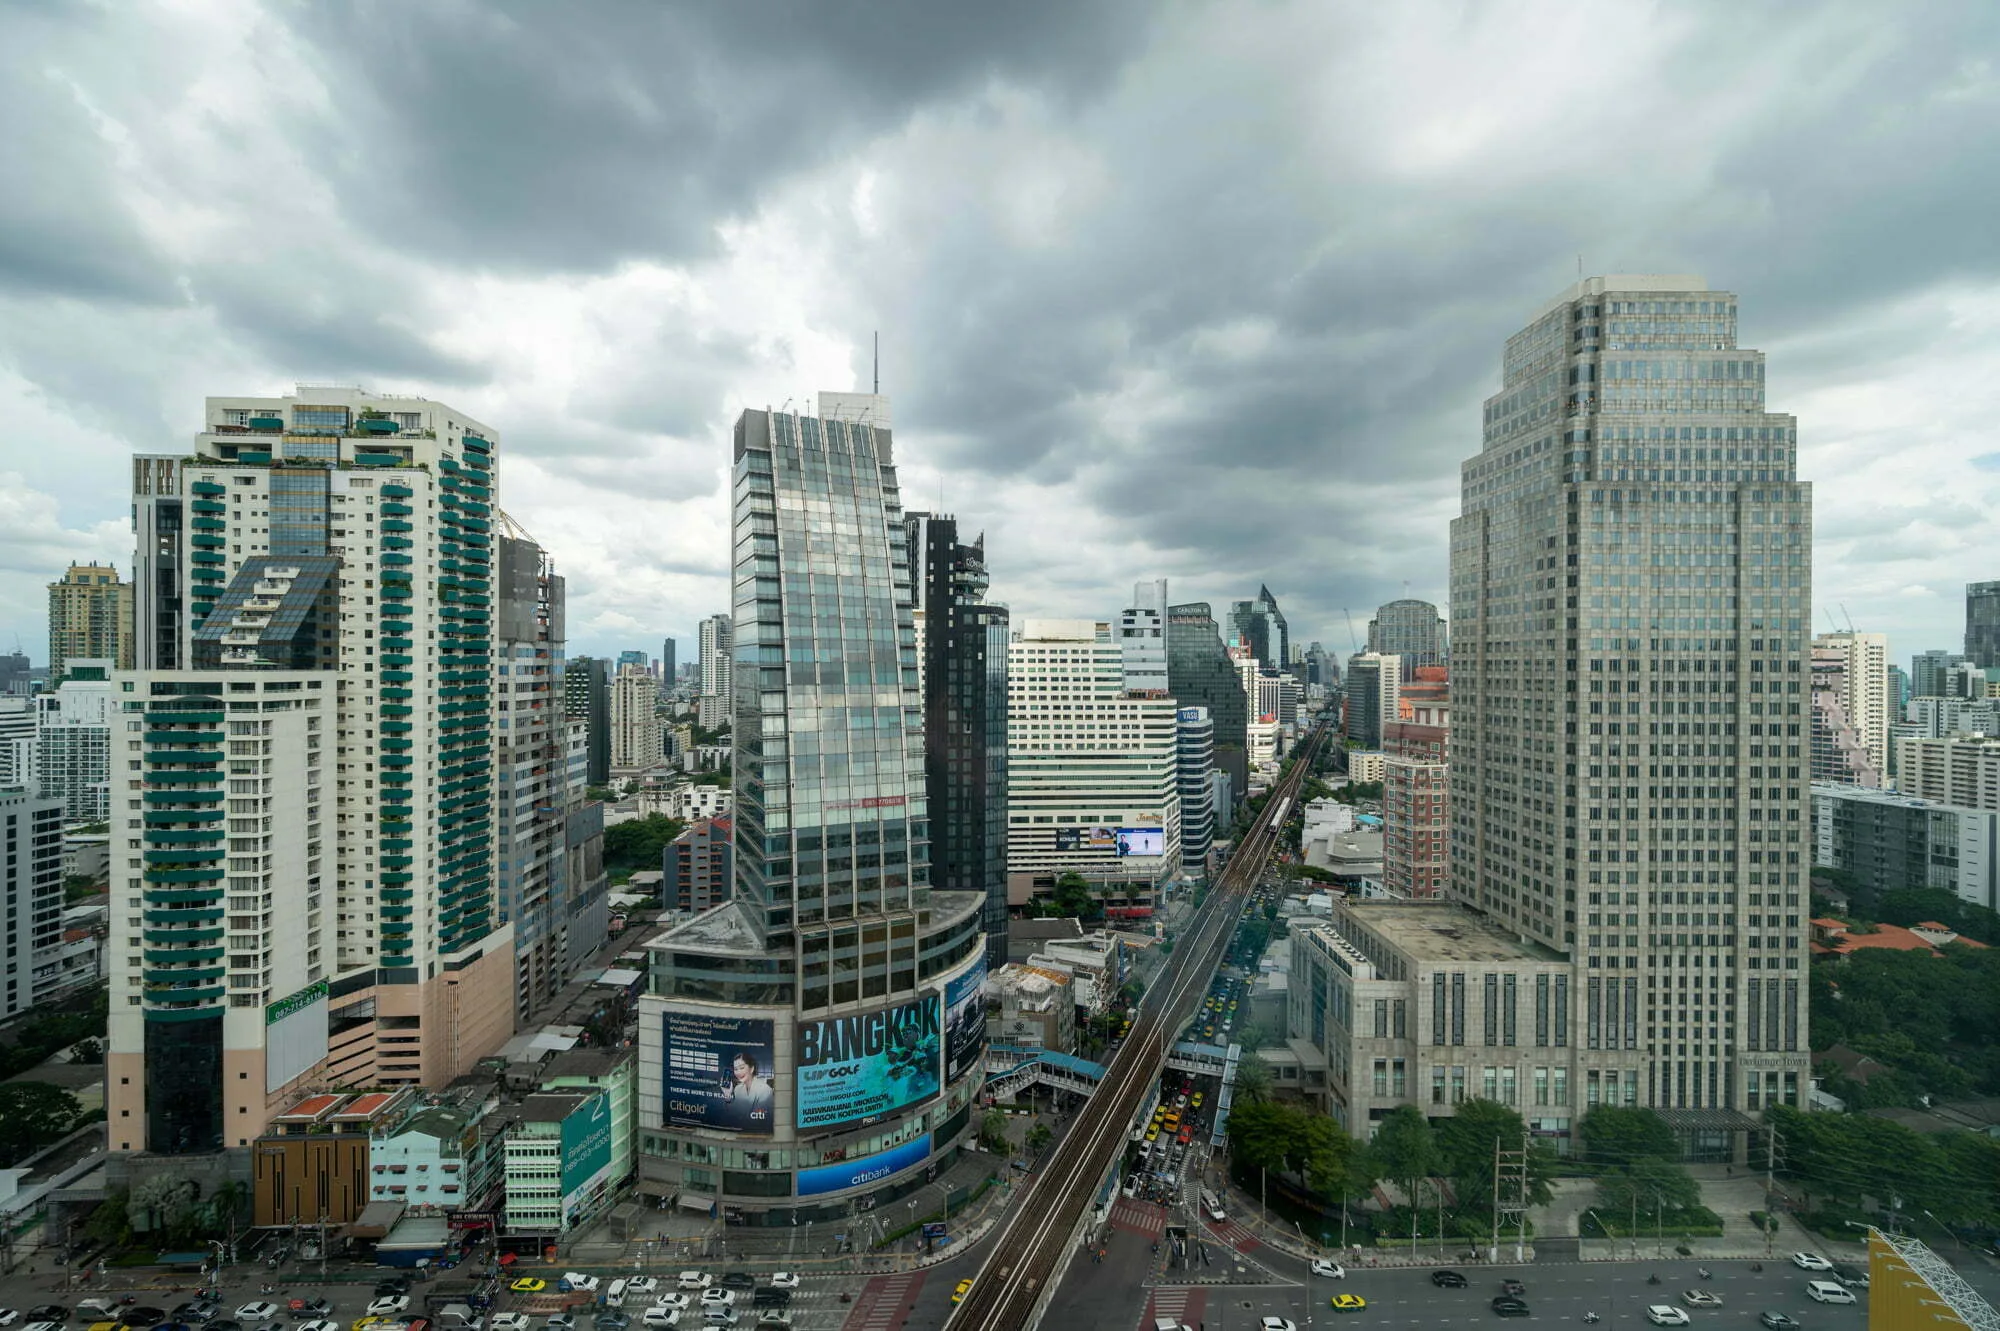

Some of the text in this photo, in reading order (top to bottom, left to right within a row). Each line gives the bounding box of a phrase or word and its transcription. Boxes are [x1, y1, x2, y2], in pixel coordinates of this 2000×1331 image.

[798, 996, 940, 1067] BANGKOK
[828, 1064, 860, 1078] GOLF
[851, 1165, 891, 1185] citibank
